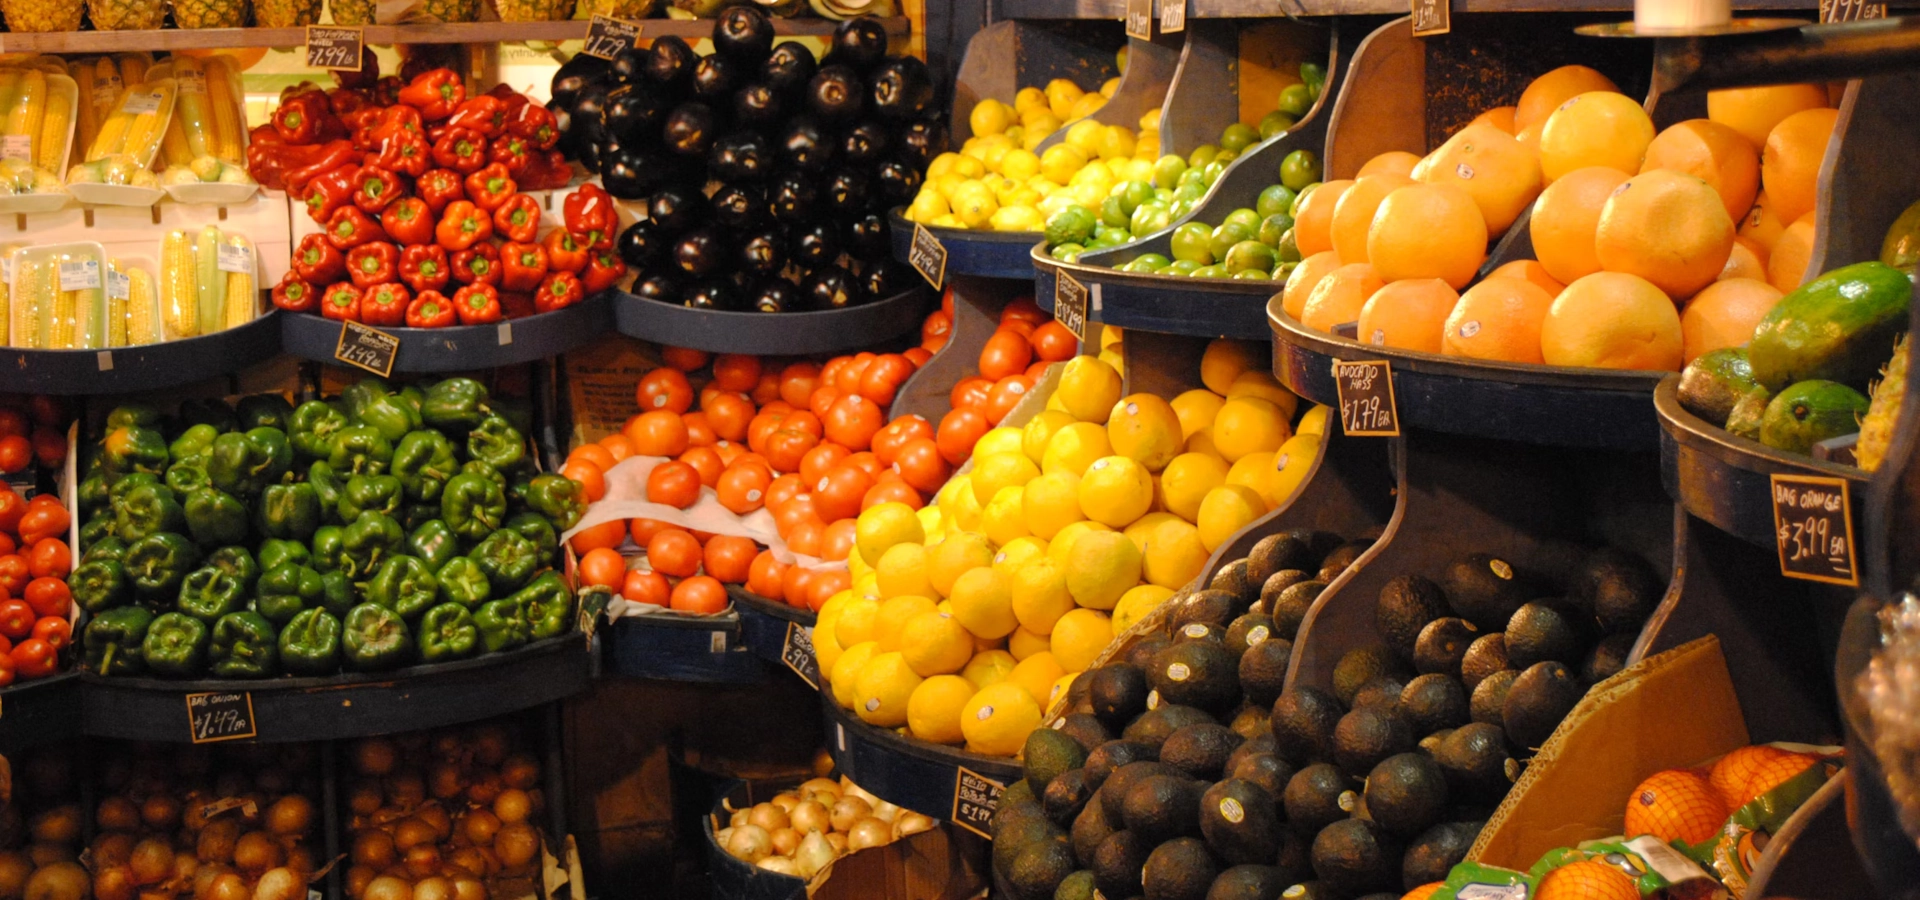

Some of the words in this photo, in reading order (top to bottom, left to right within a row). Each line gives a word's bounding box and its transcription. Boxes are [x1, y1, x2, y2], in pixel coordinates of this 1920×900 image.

[1339, 364, 1378, 379] AVOCADO
[1349, 379, 1372, 390] HASS
[1343, 395, 1380, 431] $1.79
[1776, 484, 1797, 507] BAG
[1799, 490, 1842, 512] ORANGE
[1779, 516, 1828, 561] $3.99
[191, 695, 208, 707] BAG
[211, 694, 242, 704] ONION
